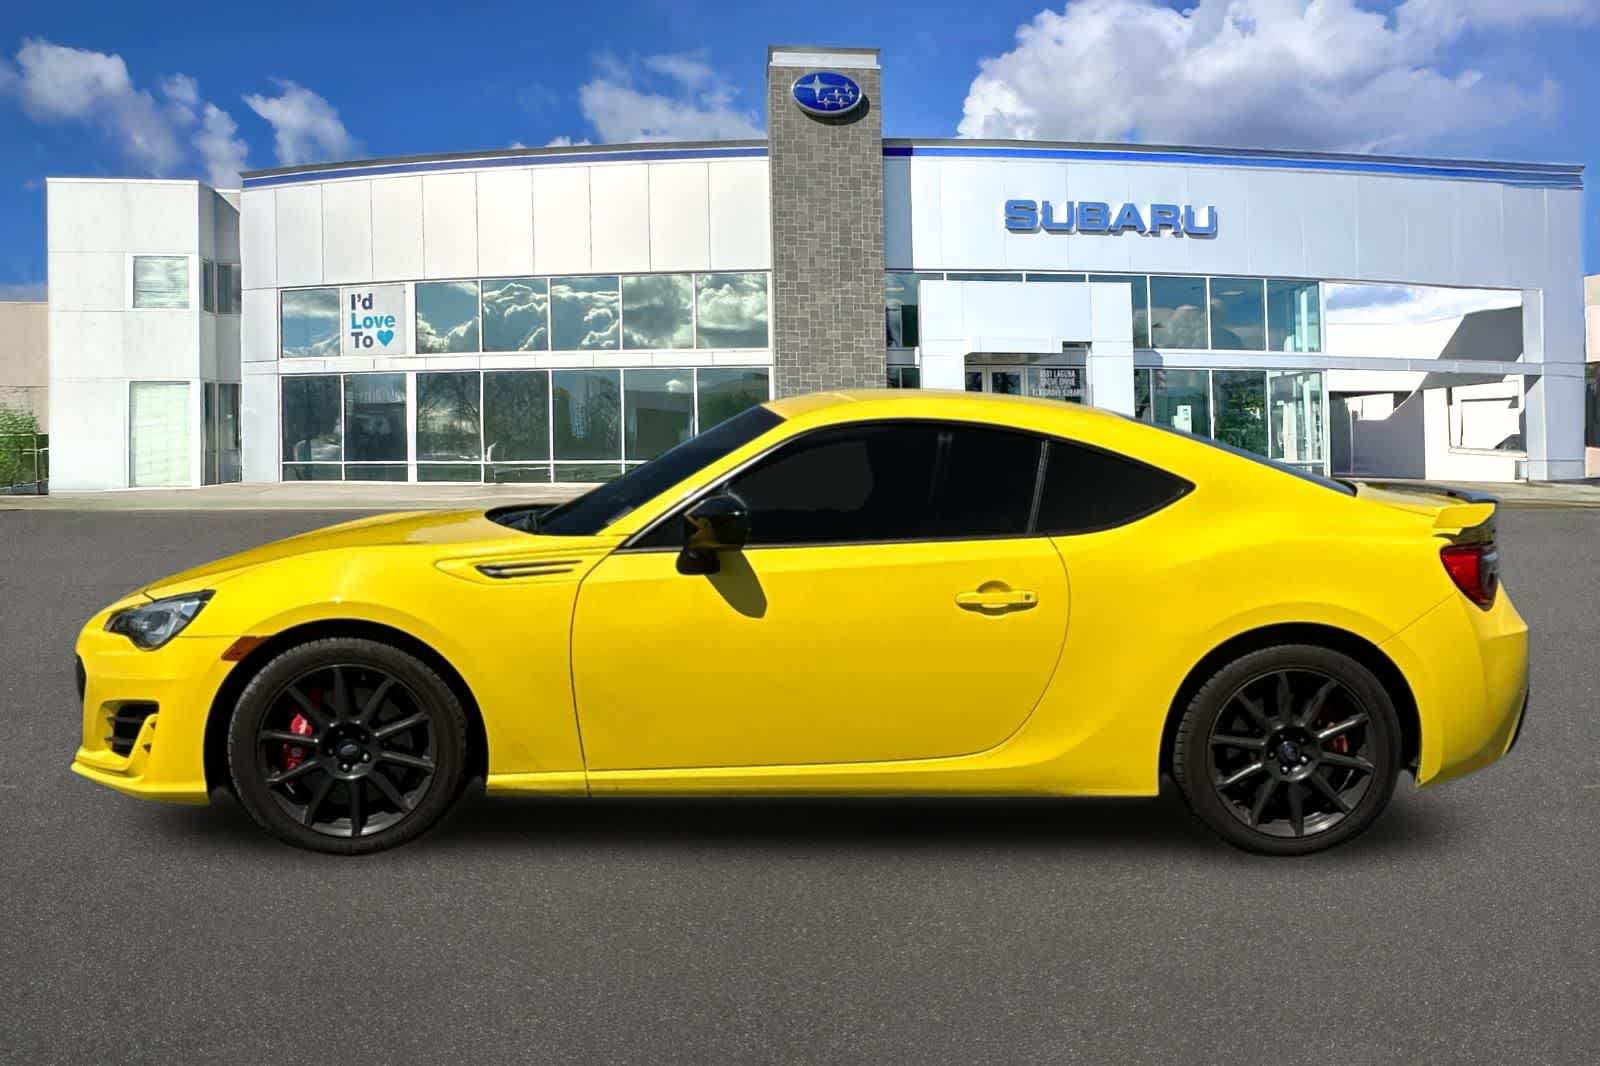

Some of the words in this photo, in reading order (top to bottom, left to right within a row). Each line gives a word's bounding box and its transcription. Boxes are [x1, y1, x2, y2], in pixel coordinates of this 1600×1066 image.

[1005, 199, 1217, 237] SUBARU
[351, 293, 373, 310] I'd
[351, 312, 396, 329] Love
[351, 331, 374, 349] To
